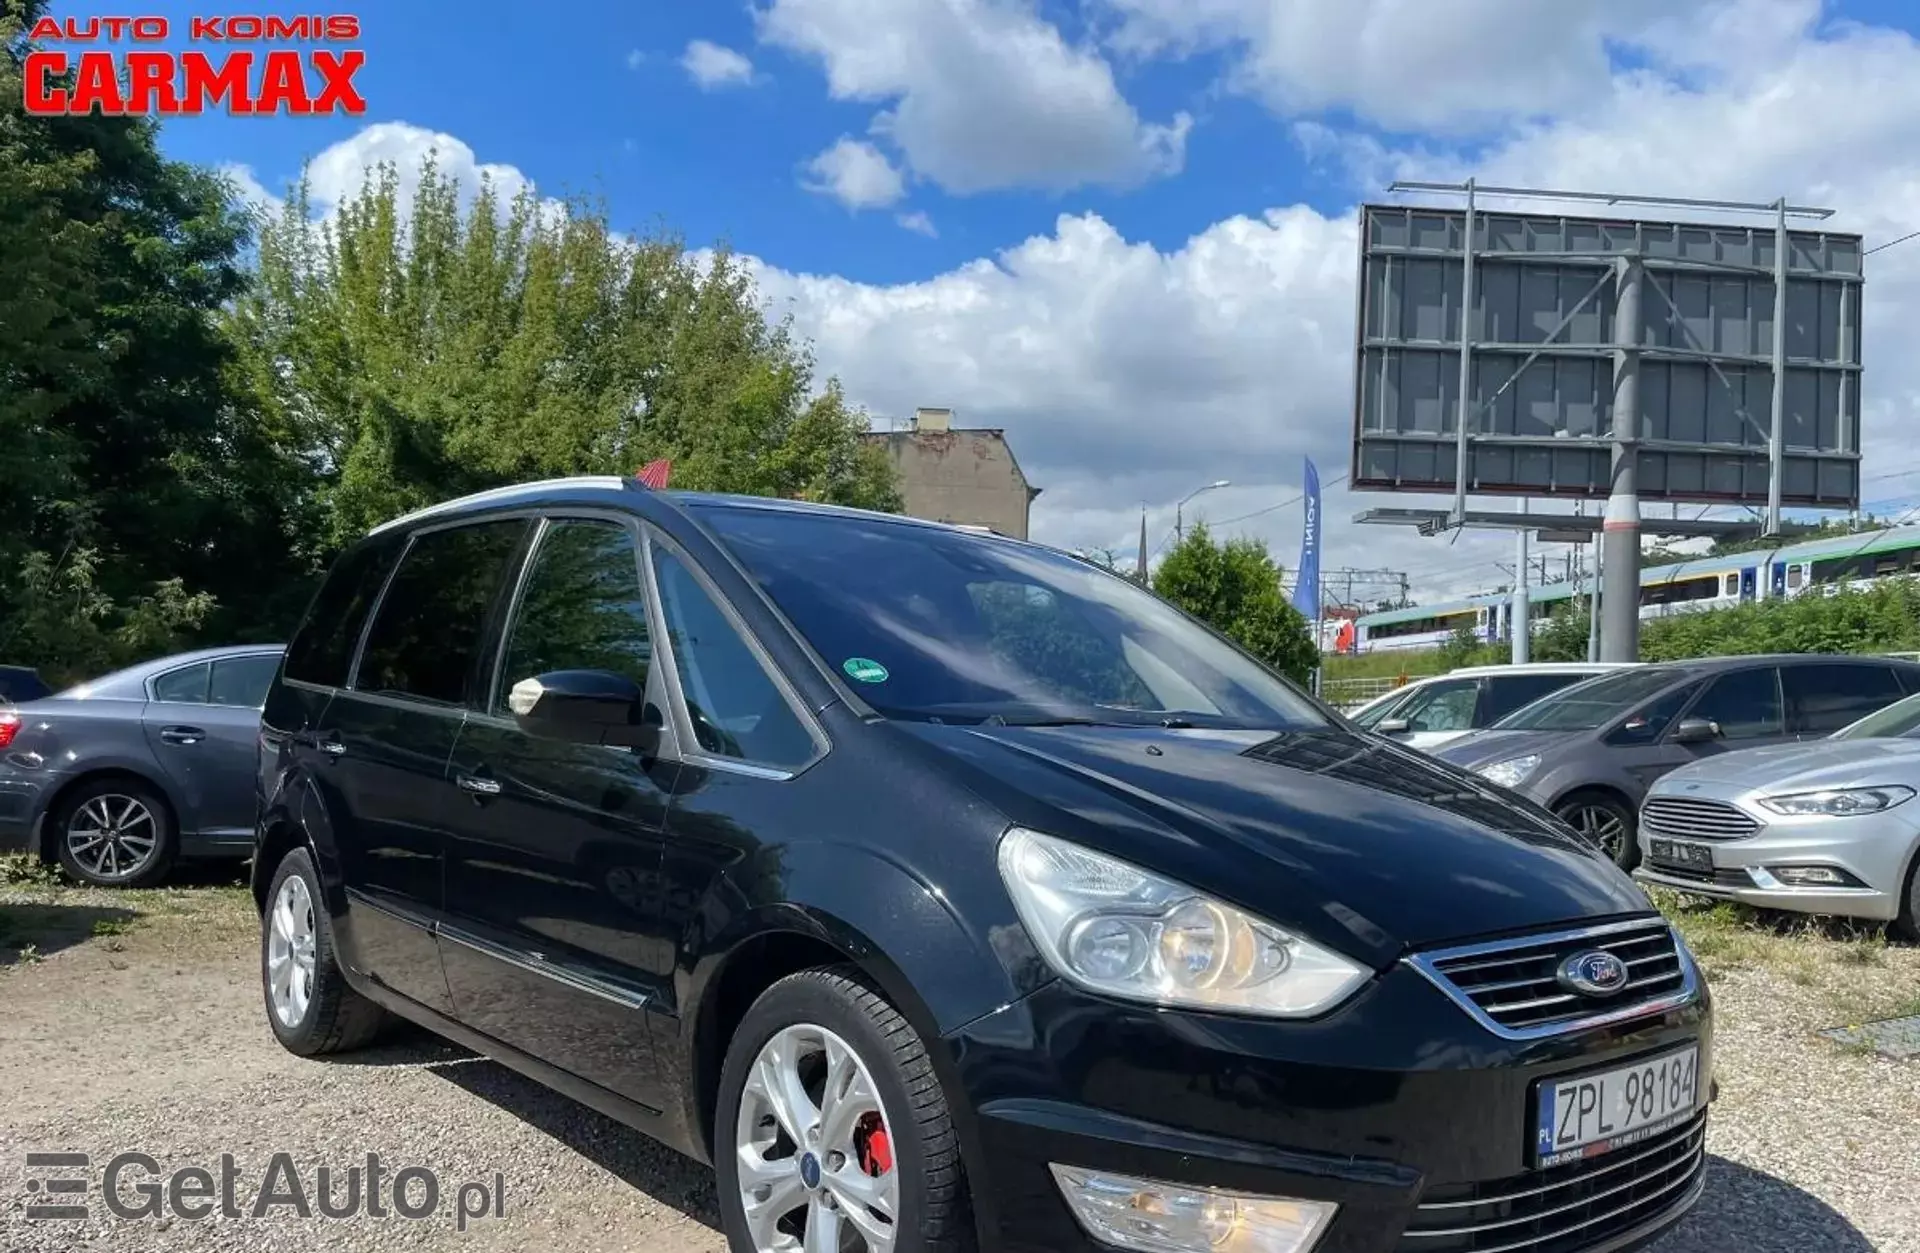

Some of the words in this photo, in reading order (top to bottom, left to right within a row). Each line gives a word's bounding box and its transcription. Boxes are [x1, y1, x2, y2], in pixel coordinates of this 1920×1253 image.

[1557, 1080, 1614, 1145] ZPL
[1625, 1054, 1694, 1127] 98184
[1538, 1129, 1552, 1144] PL
